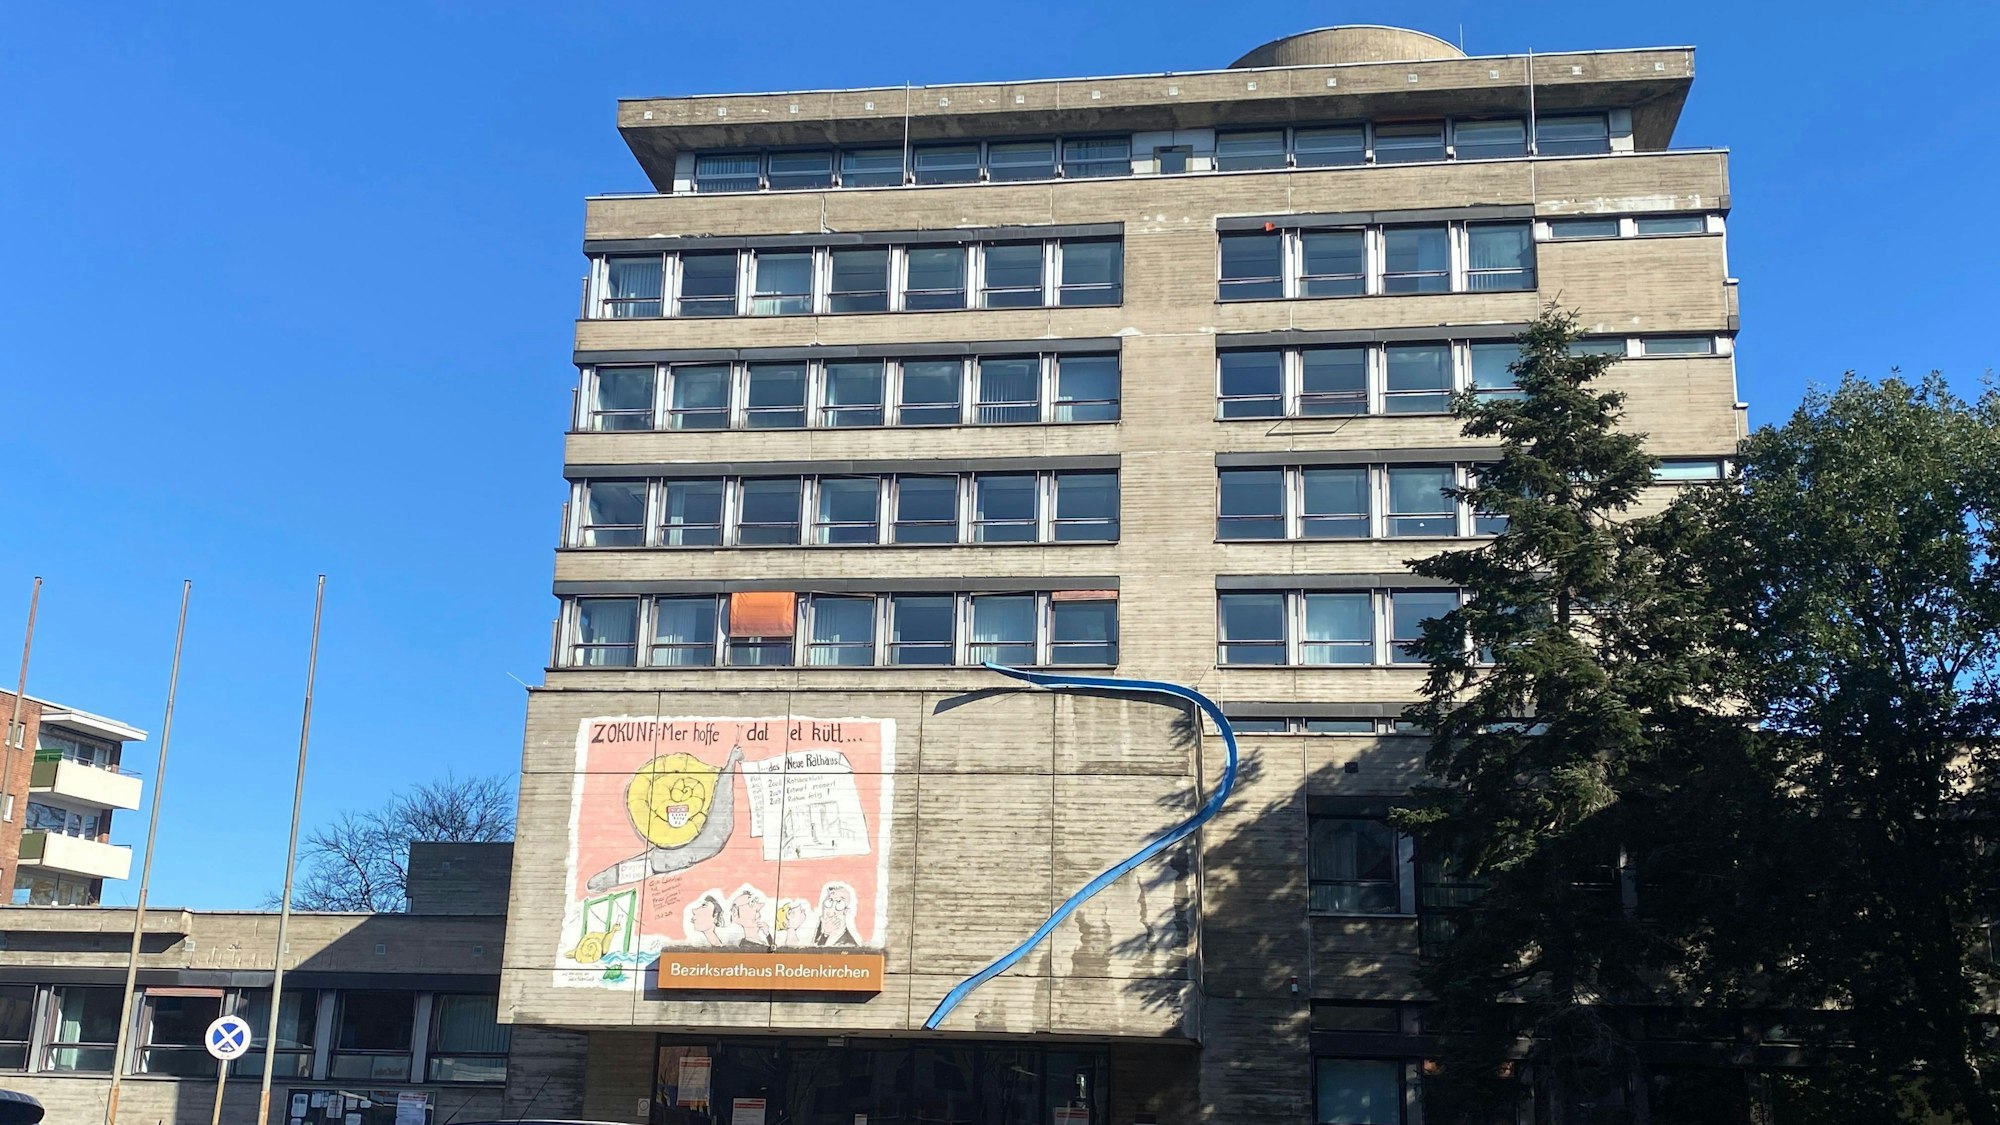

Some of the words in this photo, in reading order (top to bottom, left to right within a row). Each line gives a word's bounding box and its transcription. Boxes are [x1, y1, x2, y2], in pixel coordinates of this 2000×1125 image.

[662, 722, 688, 741] Mer
[694, 722, 720, 746] hoffe
[746, 722, 768, 741] dat
[790, 721, 802, 741] et
[787, 756, 804, 770] Neue
[670, 963, 772, 977] Bezirksrathaus
[776, 964, 870, 978] Rodenkirchen
